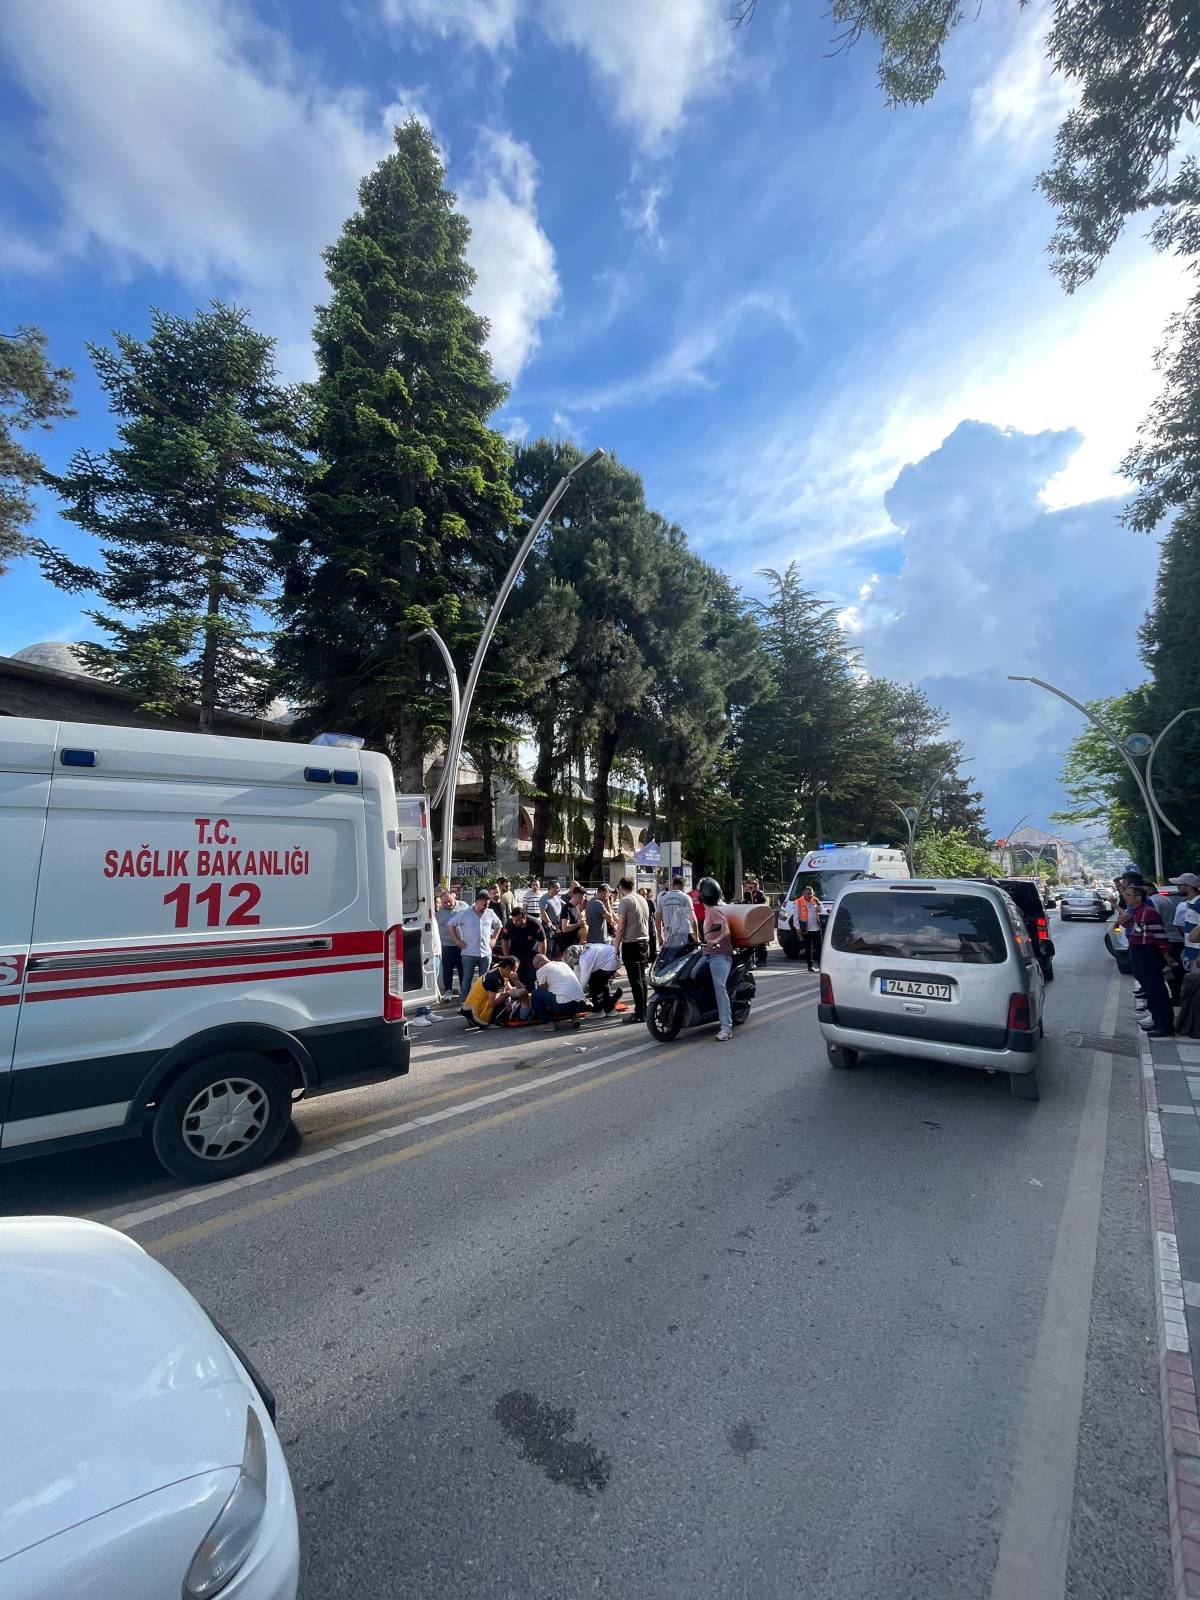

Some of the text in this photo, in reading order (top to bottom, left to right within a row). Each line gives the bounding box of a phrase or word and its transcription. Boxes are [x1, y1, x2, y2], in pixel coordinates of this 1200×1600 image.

[195, 818, 237, 845] T.C.
[103, 844, 309, 878] SAĞLIK BAKANLIĞI
[163, 882, 261, 928] 112
[889, 981, 949, 997] 74 AZ 017
